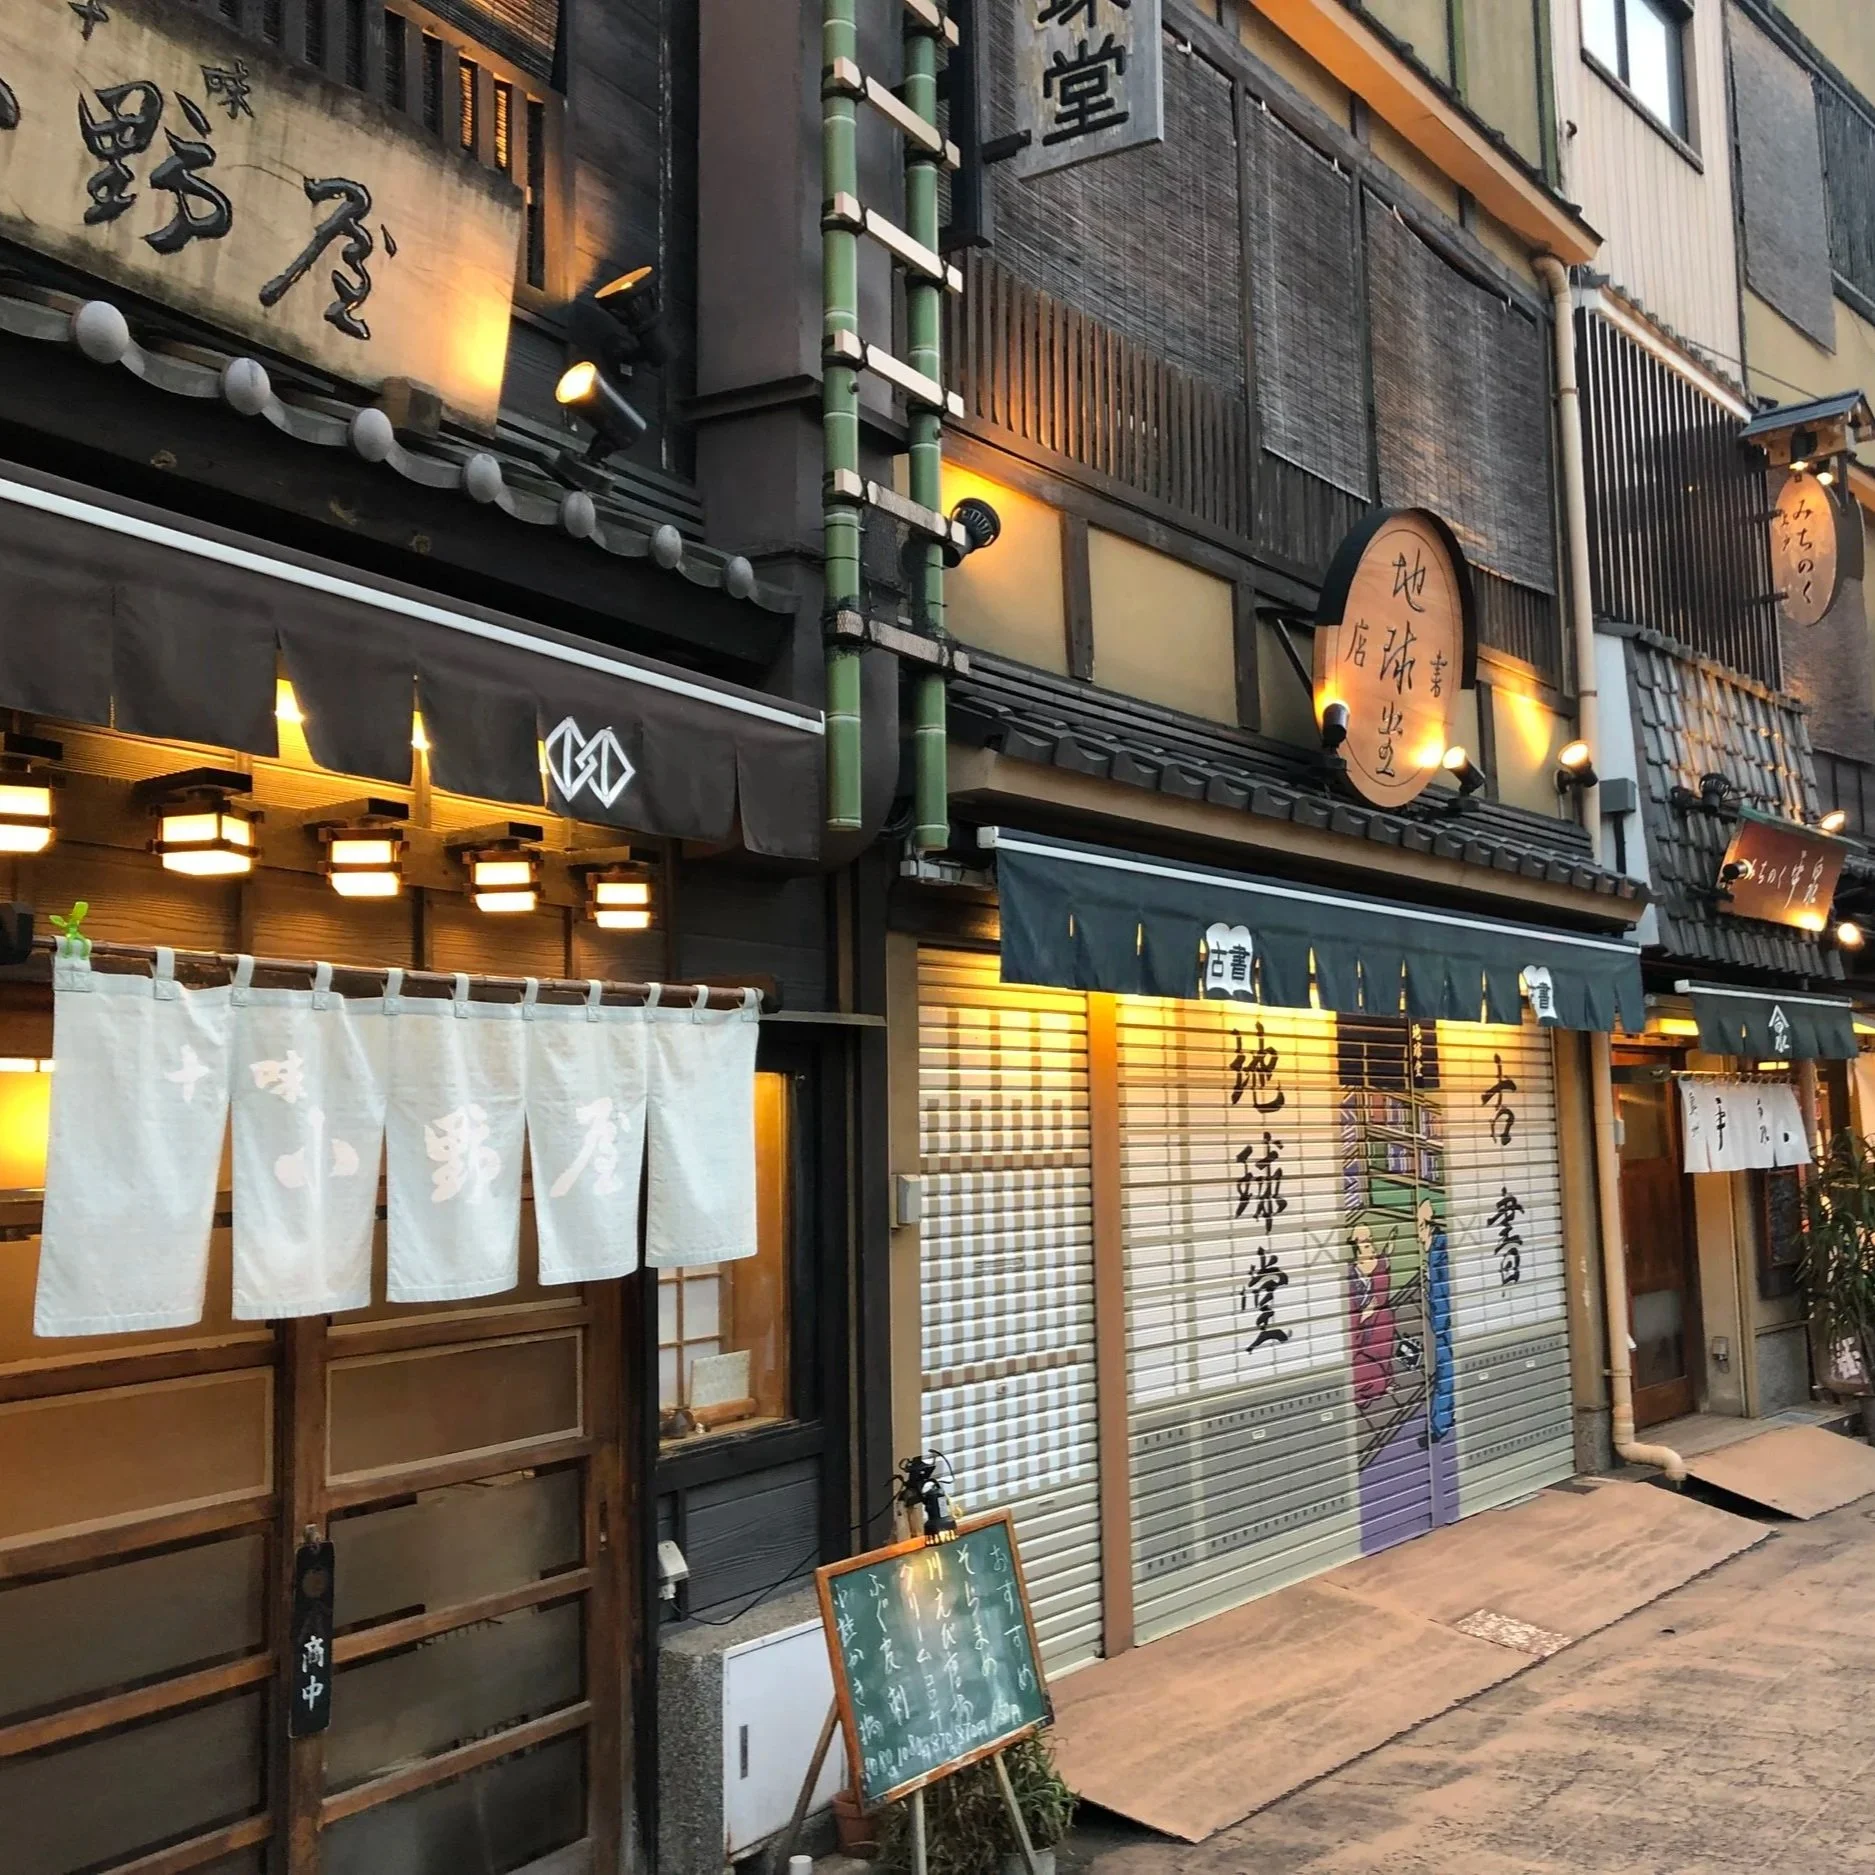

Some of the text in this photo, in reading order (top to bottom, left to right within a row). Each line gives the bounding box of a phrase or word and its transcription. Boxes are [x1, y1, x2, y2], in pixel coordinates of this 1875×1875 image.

[0, 78, 396, 341] 野屋
[1793, 499, 1814, 604] みちのく
[1210, 942, 1251, 981] 古書
[1230, 1021, 1293, 1353] 地球堂
[1480, 1052, 1526, 1286] 古書
[989, 1544, 1037, 1692] おすすめ
